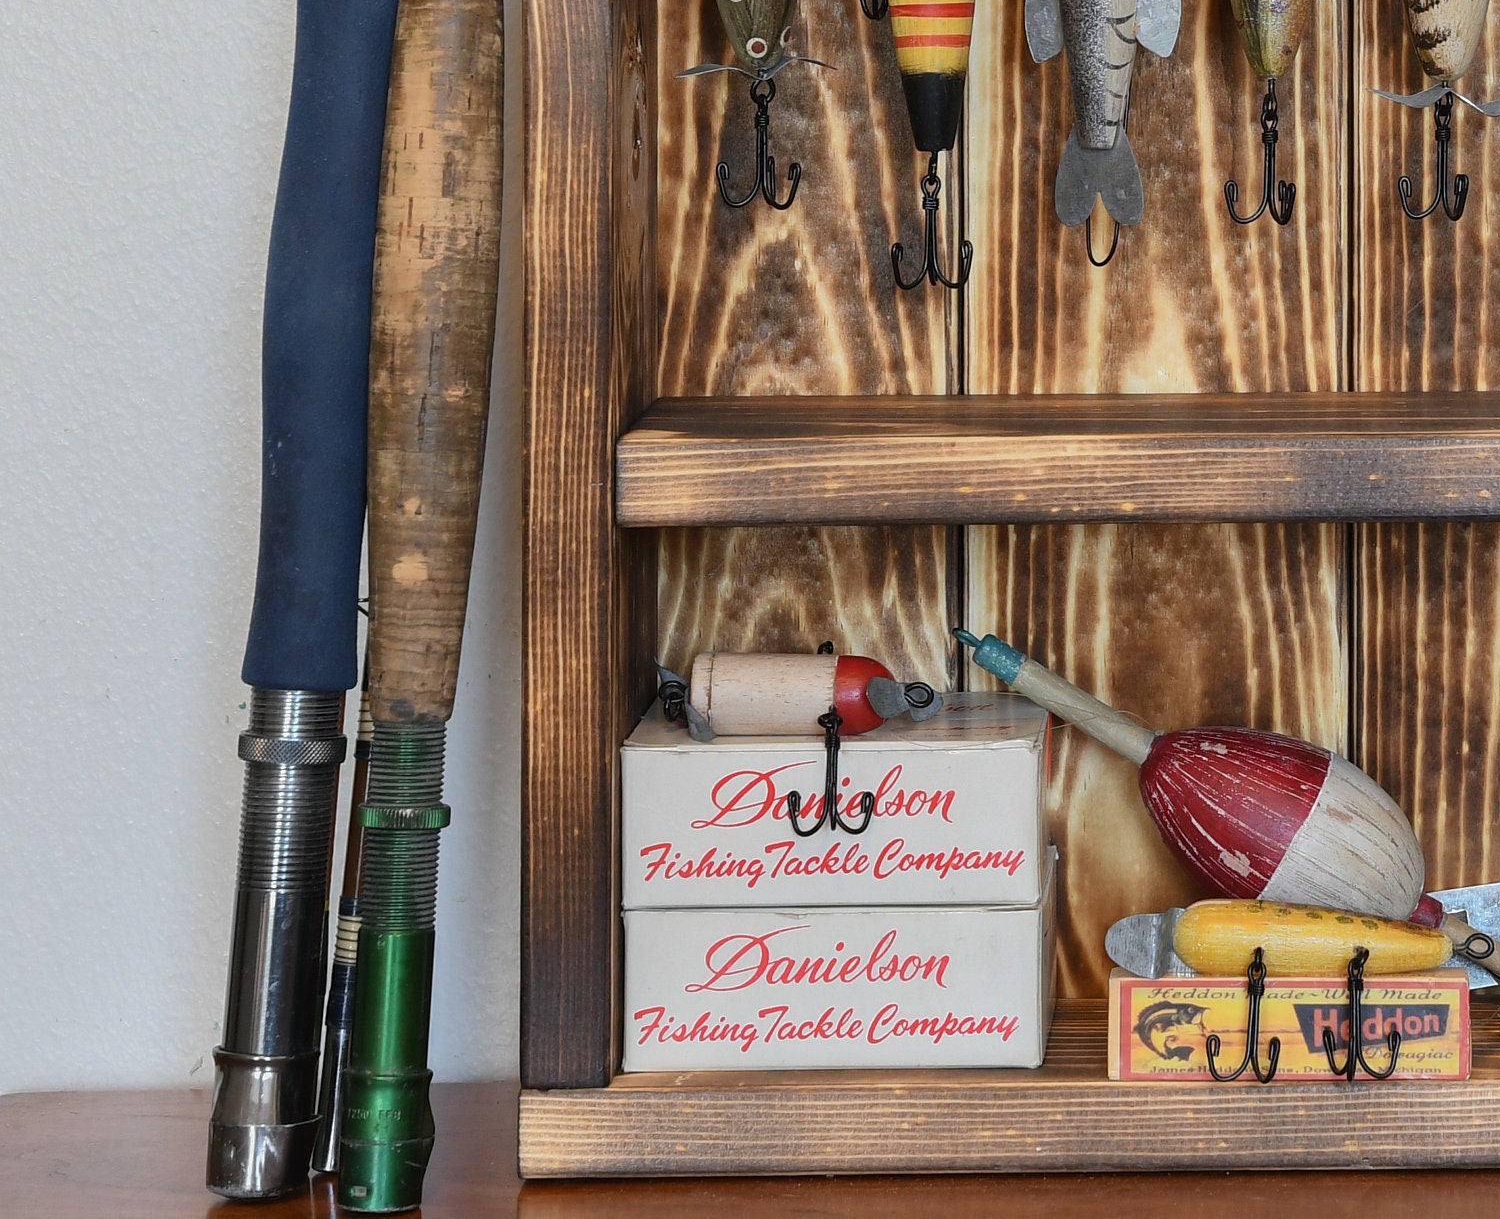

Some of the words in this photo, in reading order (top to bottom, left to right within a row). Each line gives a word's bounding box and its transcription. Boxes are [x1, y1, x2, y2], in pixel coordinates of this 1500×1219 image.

[640, 841, 766, 888] Fishing
[764, 840, 871, 879] Tackle
[873, 837, 1025, 879] Company
[685, 925, 952, 993] Danielson
[1147, 988, 1236, 1000] Heddon
[1245, 988, 1304, 1000] ade
[1378, 989, 1442, 1000] Made
[634, 1005, 758, 1053] Fishing
[757, 1005, 863, 1041] Tackle
[866, 1003, 1020, 1045] Company
[1378, 1066, 1442, 1074] Mchigan
